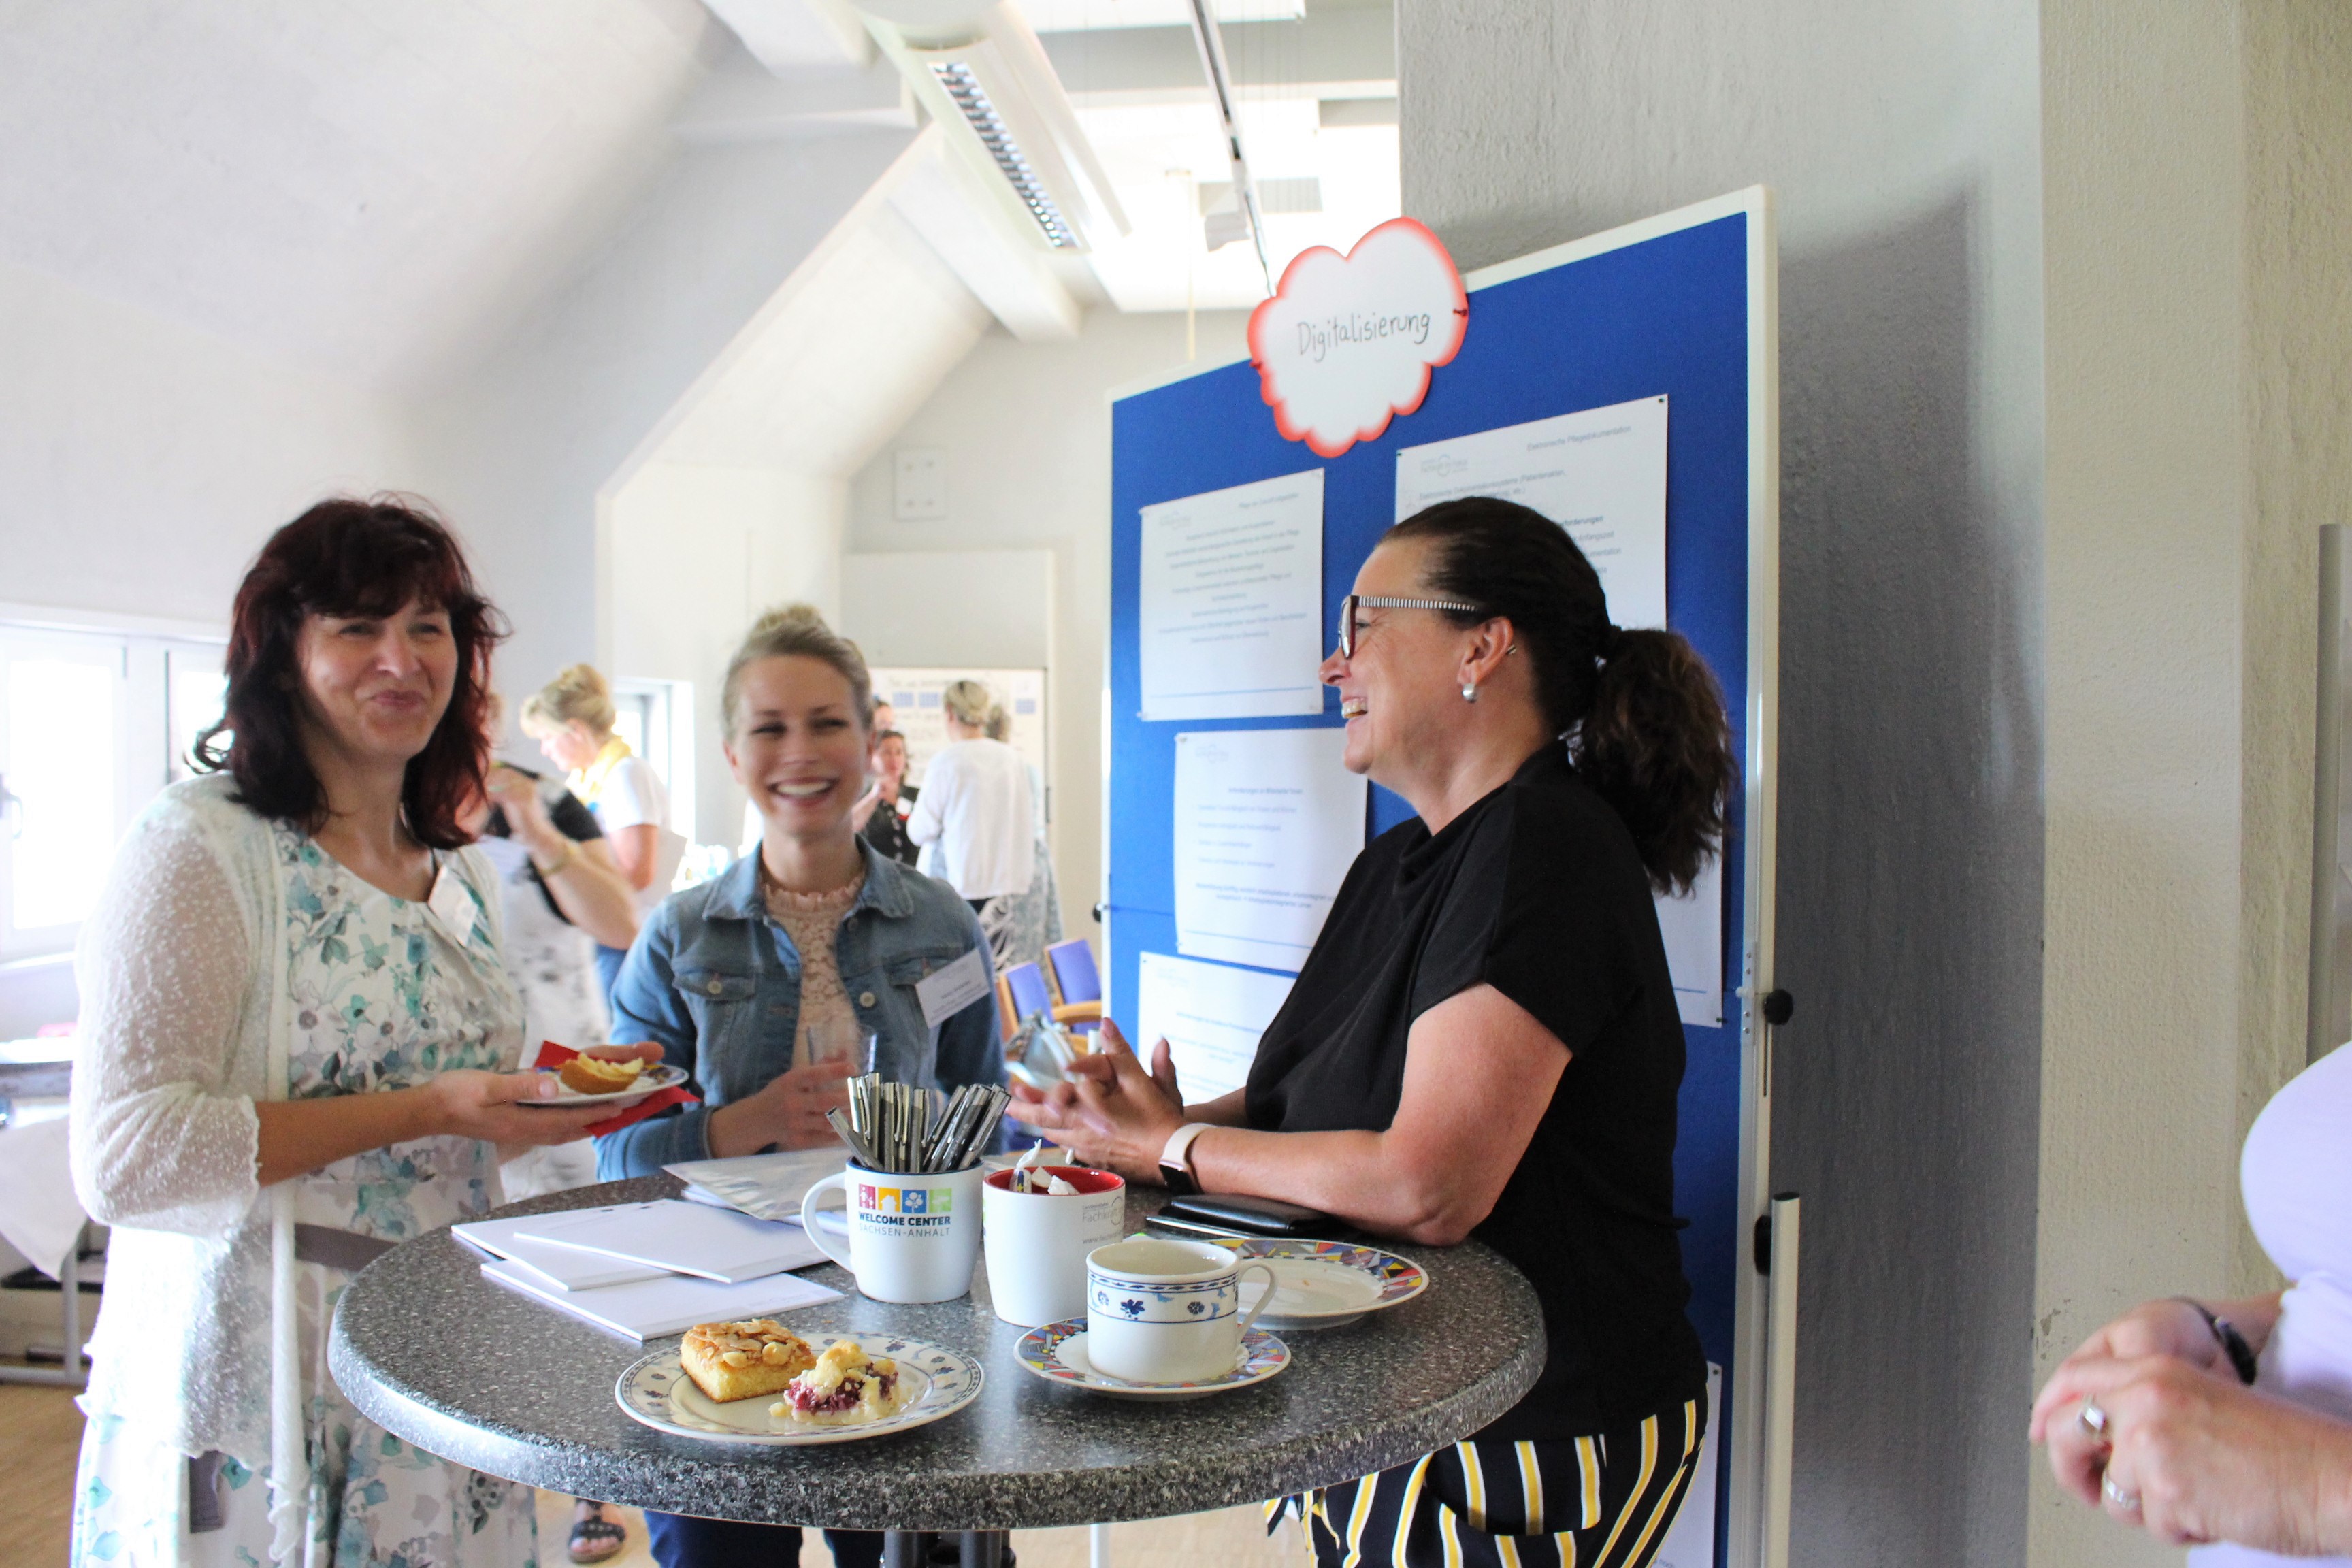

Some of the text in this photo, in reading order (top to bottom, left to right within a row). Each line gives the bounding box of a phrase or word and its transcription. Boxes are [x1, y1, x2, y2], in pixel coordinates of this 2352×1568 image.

[1297, 312, 1431, 363] Digitalisierung
[858, 1211, 951, 1226] WELCOME CENTER
[858, 1222, 951, 1237] SACHSEN-ANHALT
